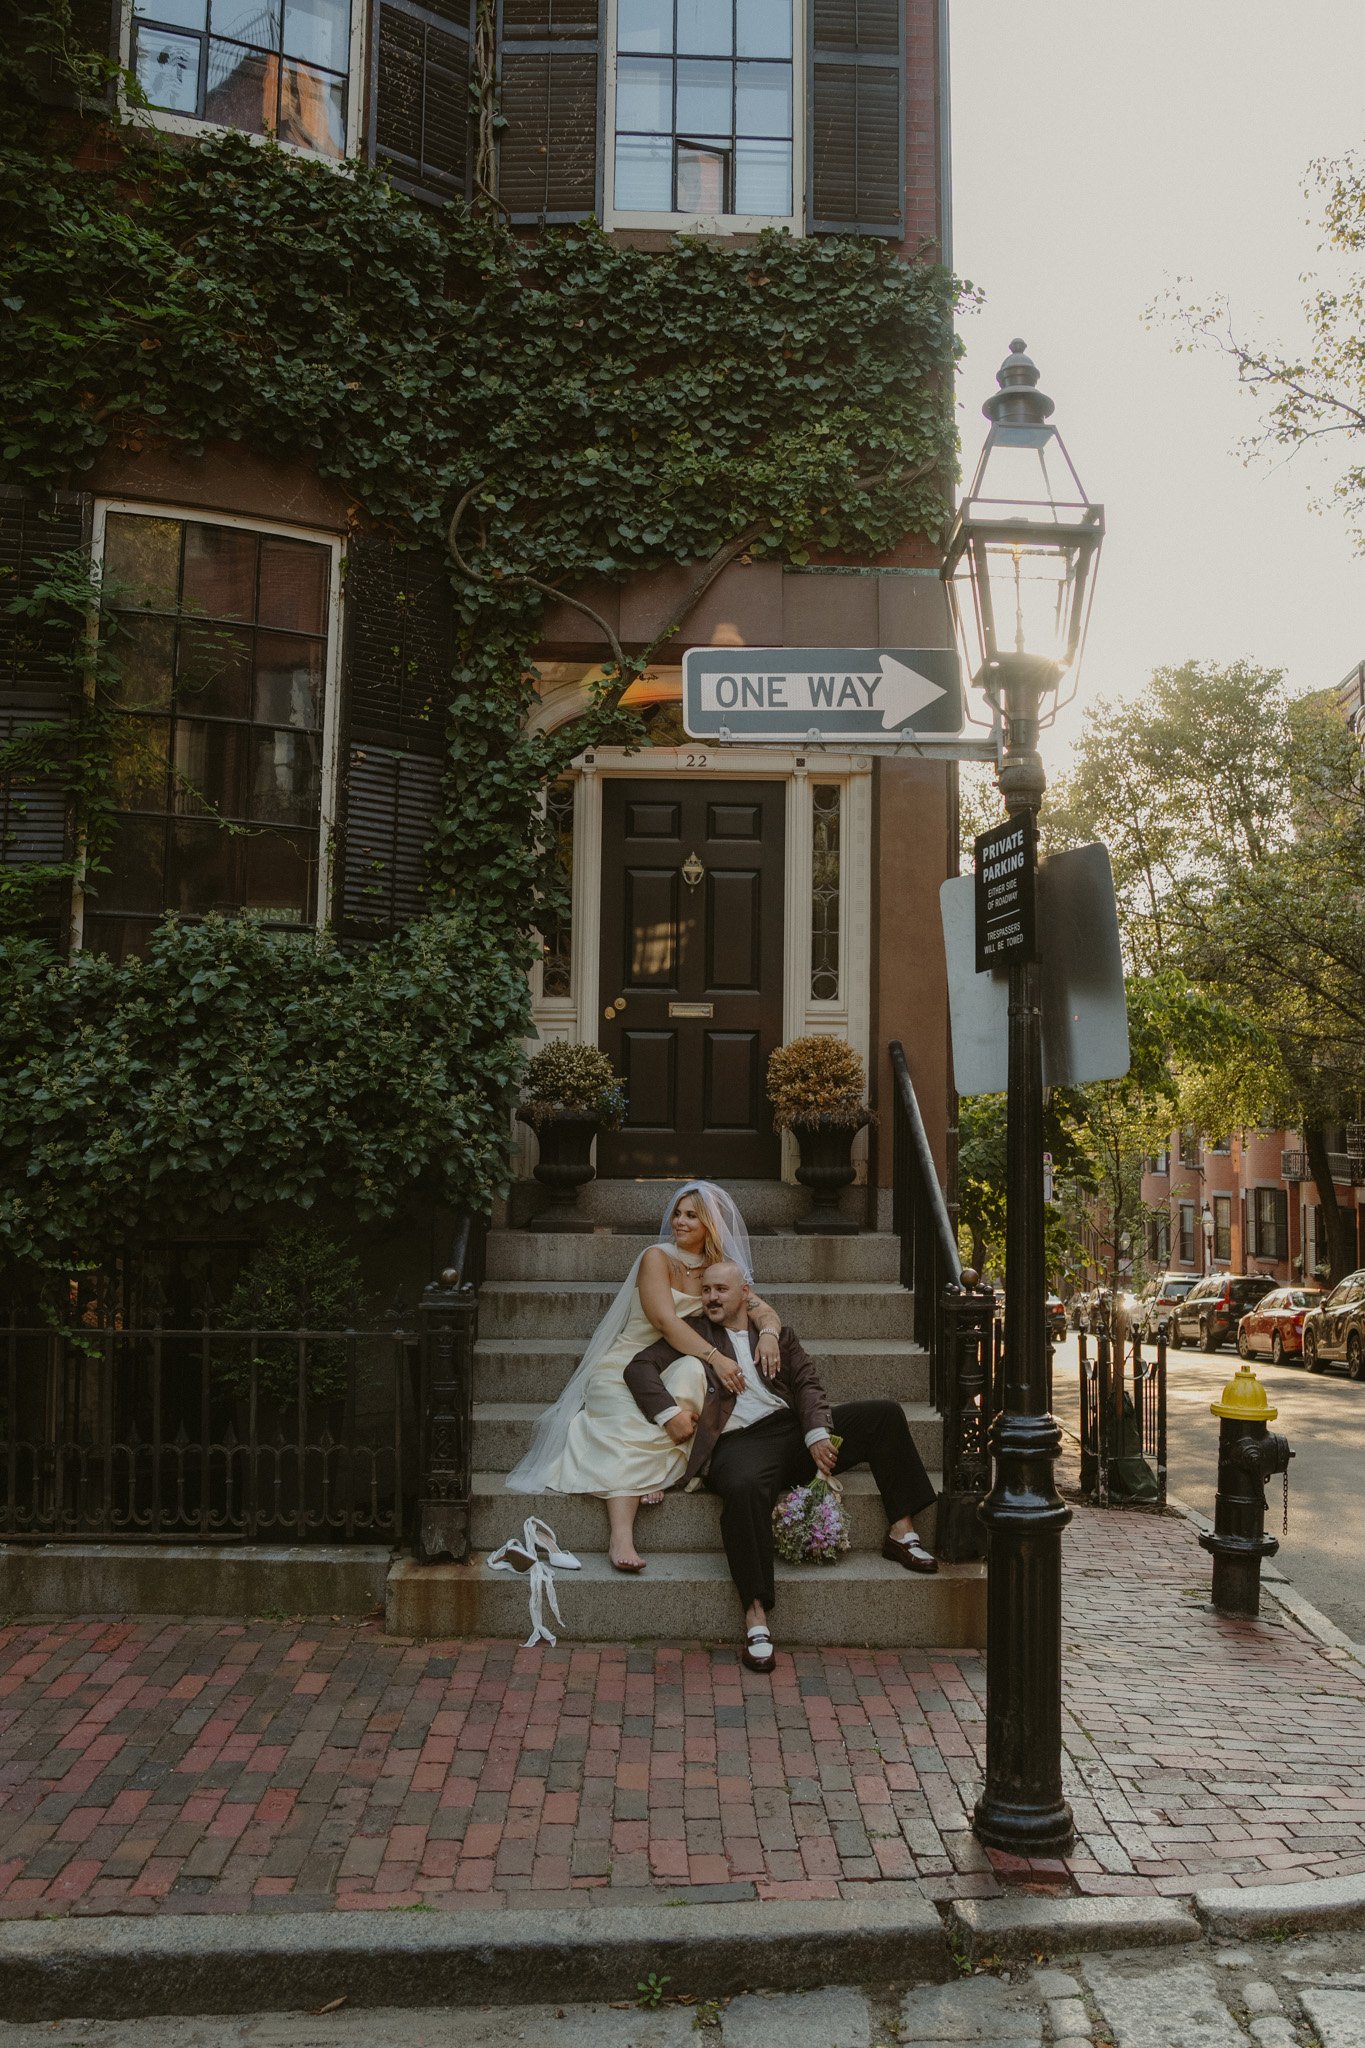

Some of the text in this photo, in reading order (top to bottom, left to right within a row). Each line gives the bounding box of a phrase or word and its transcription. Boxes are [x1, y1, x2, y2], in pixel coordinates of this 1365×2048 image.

[715, 676, 883, 708] ONE WAY
[686, 754, 707, 767] 22
[982, 829, 1024, 863] PRIVATE
[982, 851, 1025, 884] PARKING
[988, 878, 1017, 898] EITHER SIDE
[987, 890, 1019, 911] OF ROADWAY
[987, 922, 1021, 942] TRESPASSERS
[984, 933, 1024, 955] WILL BE TOWED
